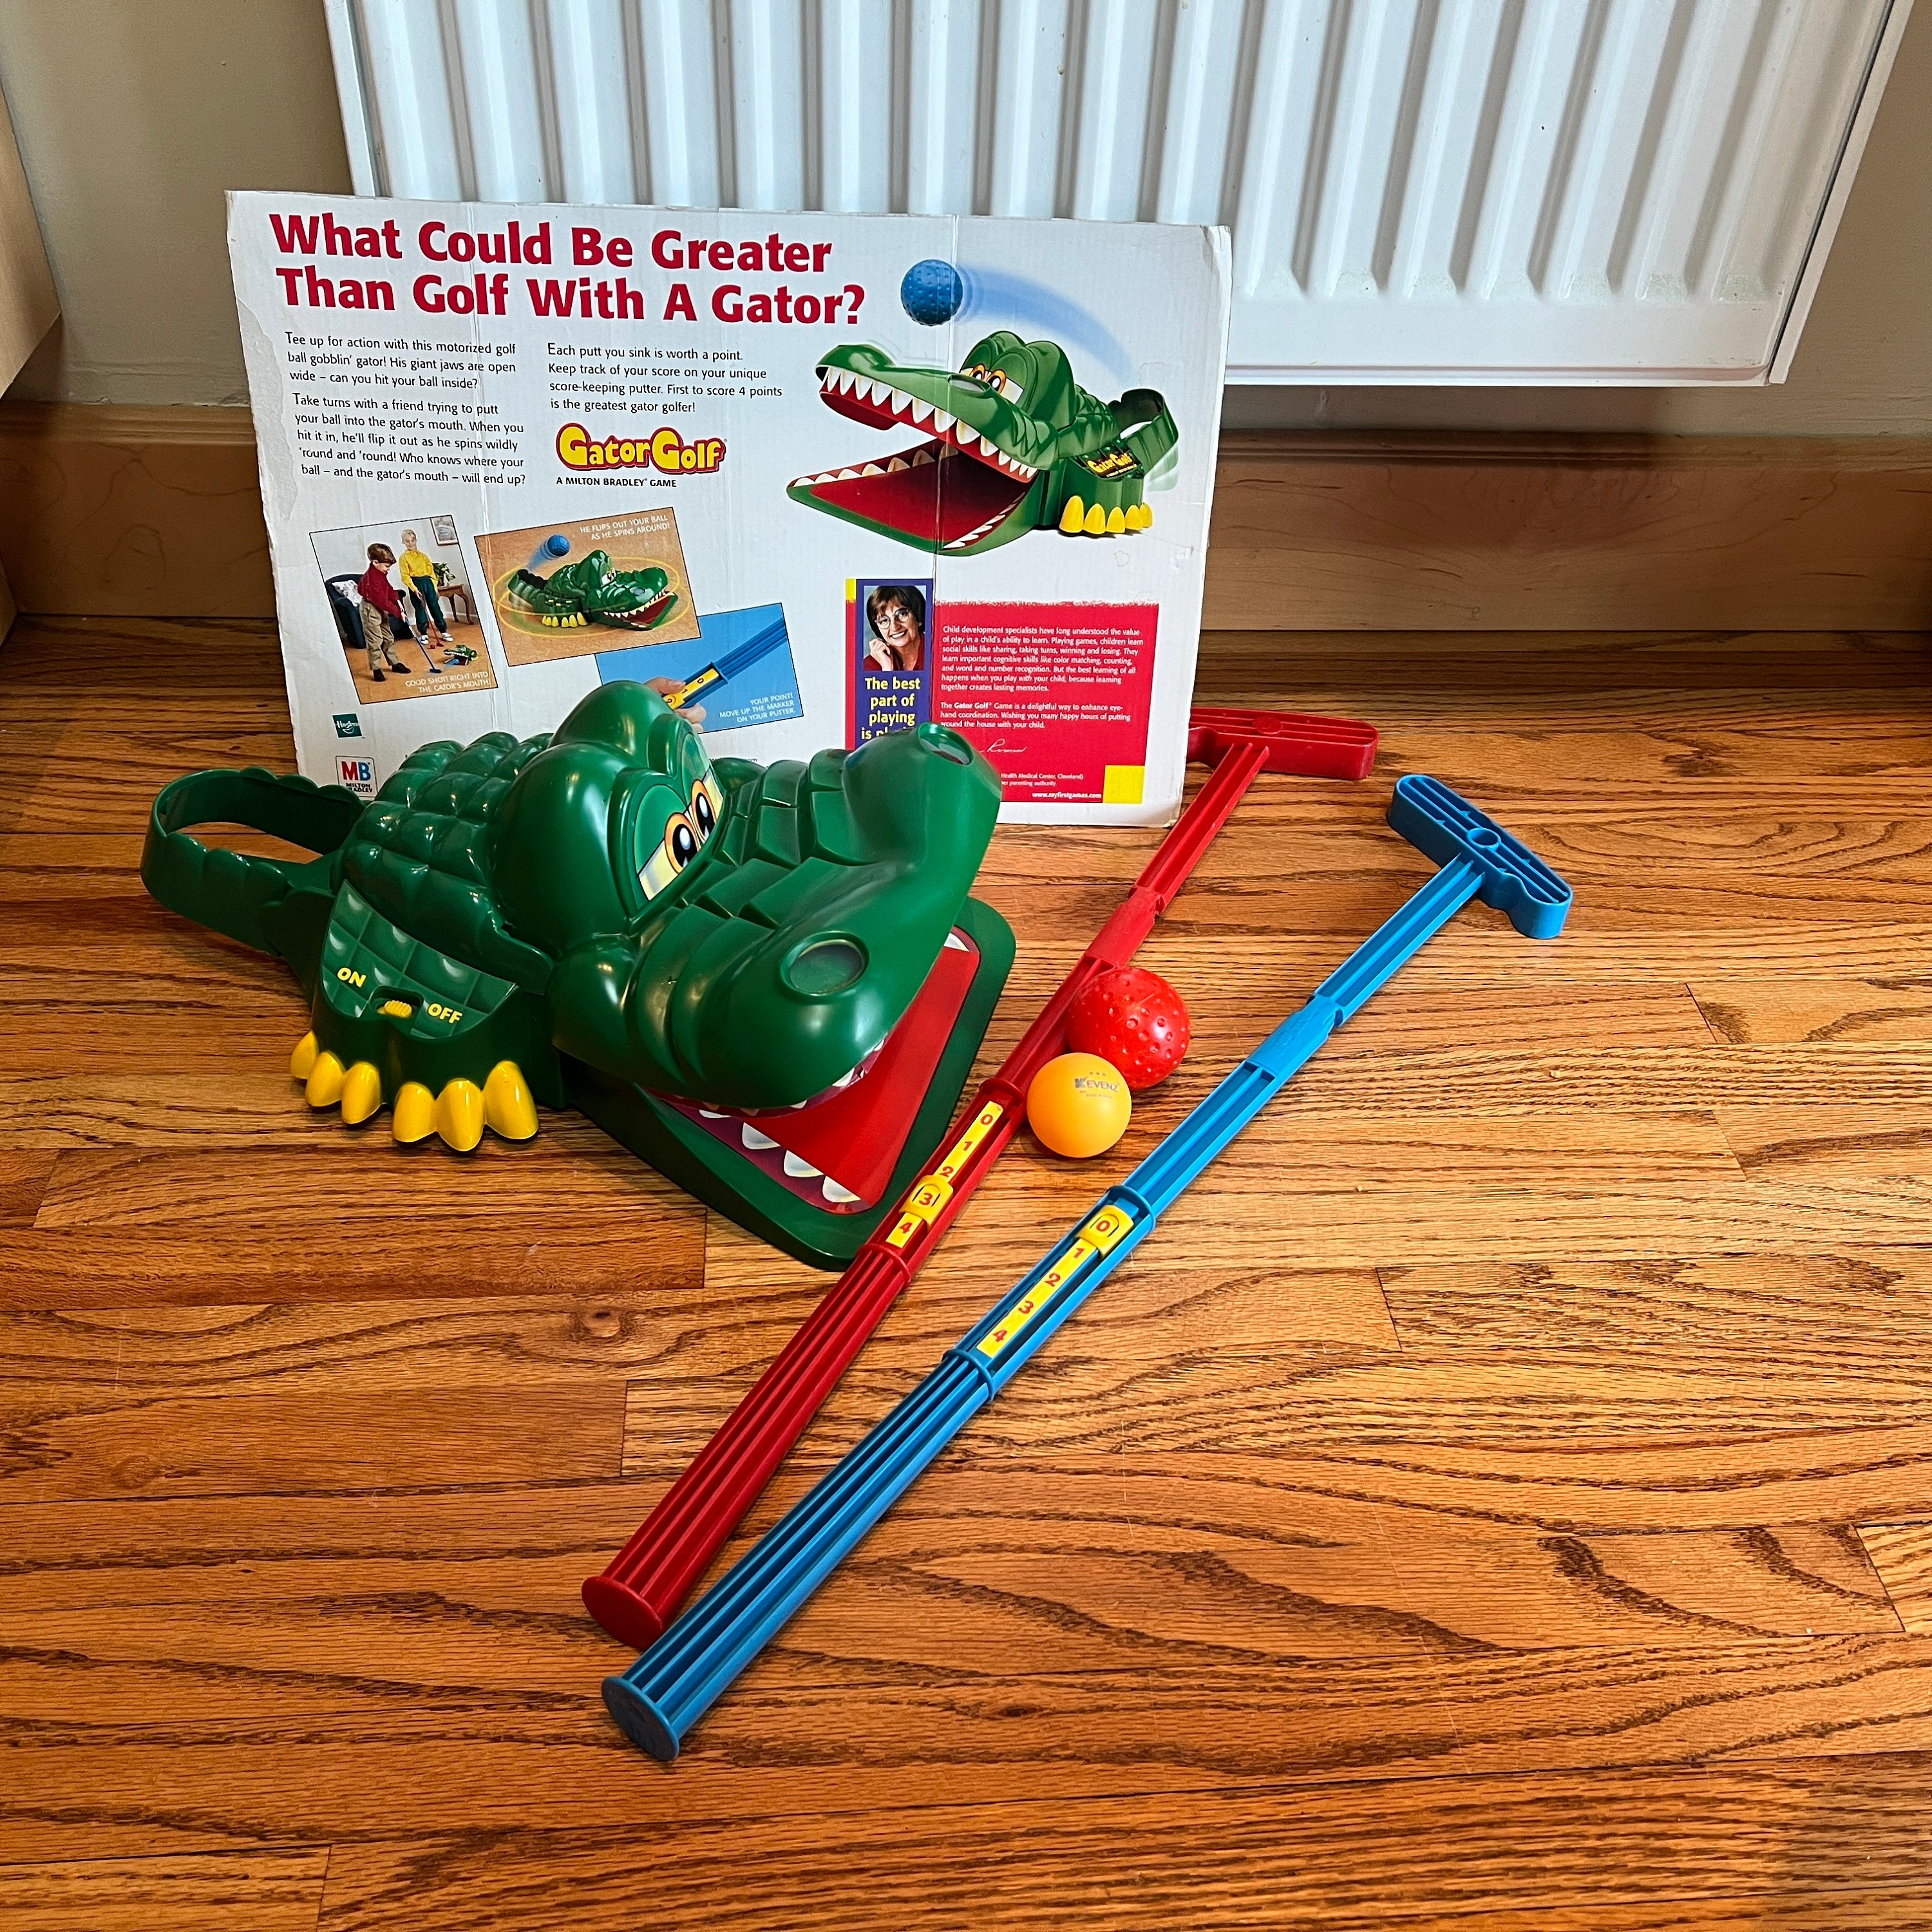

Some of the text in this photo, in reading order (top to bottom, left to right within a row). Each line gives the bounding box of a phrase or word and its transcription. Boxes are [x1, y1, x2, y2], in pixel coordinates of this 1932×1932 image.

[269, 212, 832, 272] What Could Be Greater
[276, 265, 865, 324] Than Golf With A Gator?
[284, 331, 515, 357] Tee up for action with this motorized golf
[547, 343, 576, 355] Each
[580, 347, 601, 359] putt
[605, 349, 625, 359] you
[629, 346, 650, 357] sink
[654, 347, 663, 358] is
[666, 348, 698, 359] worth
[712, 349, 743, 363] point.
[288, 351, 307, 363] ball
[310, 353, 352, 366] gobblin'
[356, 356, 386, 368] gator!
[390, 357, 407, 368] His
[410, 357, 437, 371] giant
[440, 359, 464, 372] jaws
[488, 364, 516, 375] open
[549, 363, 576, 376] Keep
[580, 363, 606, 374] track
[610, 365, 620, 375] of
[624, 368, 648, 378] your
[652, 368, 680, 377] score
[701, 370, 726, 381] your
[730, 368, 766, 381] unique
[289, 370, 316, 381] wide
[330, 374, 348, 383] can
[351, 375, 371, 386] you
[375, 374, 389, 384] hit
[392, 377, 415, 388] your
[419, 375, 438, 386] ball
[441, 377, 478, 389] inside?
[549, 381, 782, 399] score-keeping putter. First to score 4 points
[292, 392, 498, 417] Take turns with a friend trying to putt
[551, 398, 695, 415] is the greatest gator golfer!
[295, 413, 524, 435] your ball into the gator's mouth. When you
[565, 477, 600, 486] MILTON
[649, 479, 677, 488] GAME
[612, 520, 627, 529] OUT
[629, 517, 649, 526] YOUR
[650, 515, 668, 523] BALL
[613, 527, 635, 537] SPINS
[961, 625, 1003, 635] development
[1005, 627, 1037, 635] specialists
[1056, 627, 1071, 636] long
[450, 673, 470, 681] RIGHT
[864, 676, 920, 690] The best
[941, 683, 968, 692] together
[994, 683, 1014, 692] lasting
[750, 697, 769, 705] YOUR
[871, 693, 915, 710] part of
[719, 710, 739, 718] MOVE
[767, 699, 795, 710] MARKER
[748, 712, 768, 721] YOUR
[869, 710, 915, 726] playing
[861, 726, 872, 740] is
[341, 761, 371, 781] MB
[337, 967, 367, 988] ON
[428, 1003, 463, 1025] OFF
[980, 1114, 993, 1125] 0
[963, 1141, 972, 1151] 1
[939, 1166, 954, 1178] 2
[919, 1193, 933, 1206] 3
[898, 1222, 913, 1234] 4
[1095, 1220, 1110, 1232] 0
[1072, 1247, 1084, 1259] 1
[1044, 1273, 1061, 1287] 2
[1018, 1300, 1034, 1314] 3
[992, 1329, 1007, 1343] 4
